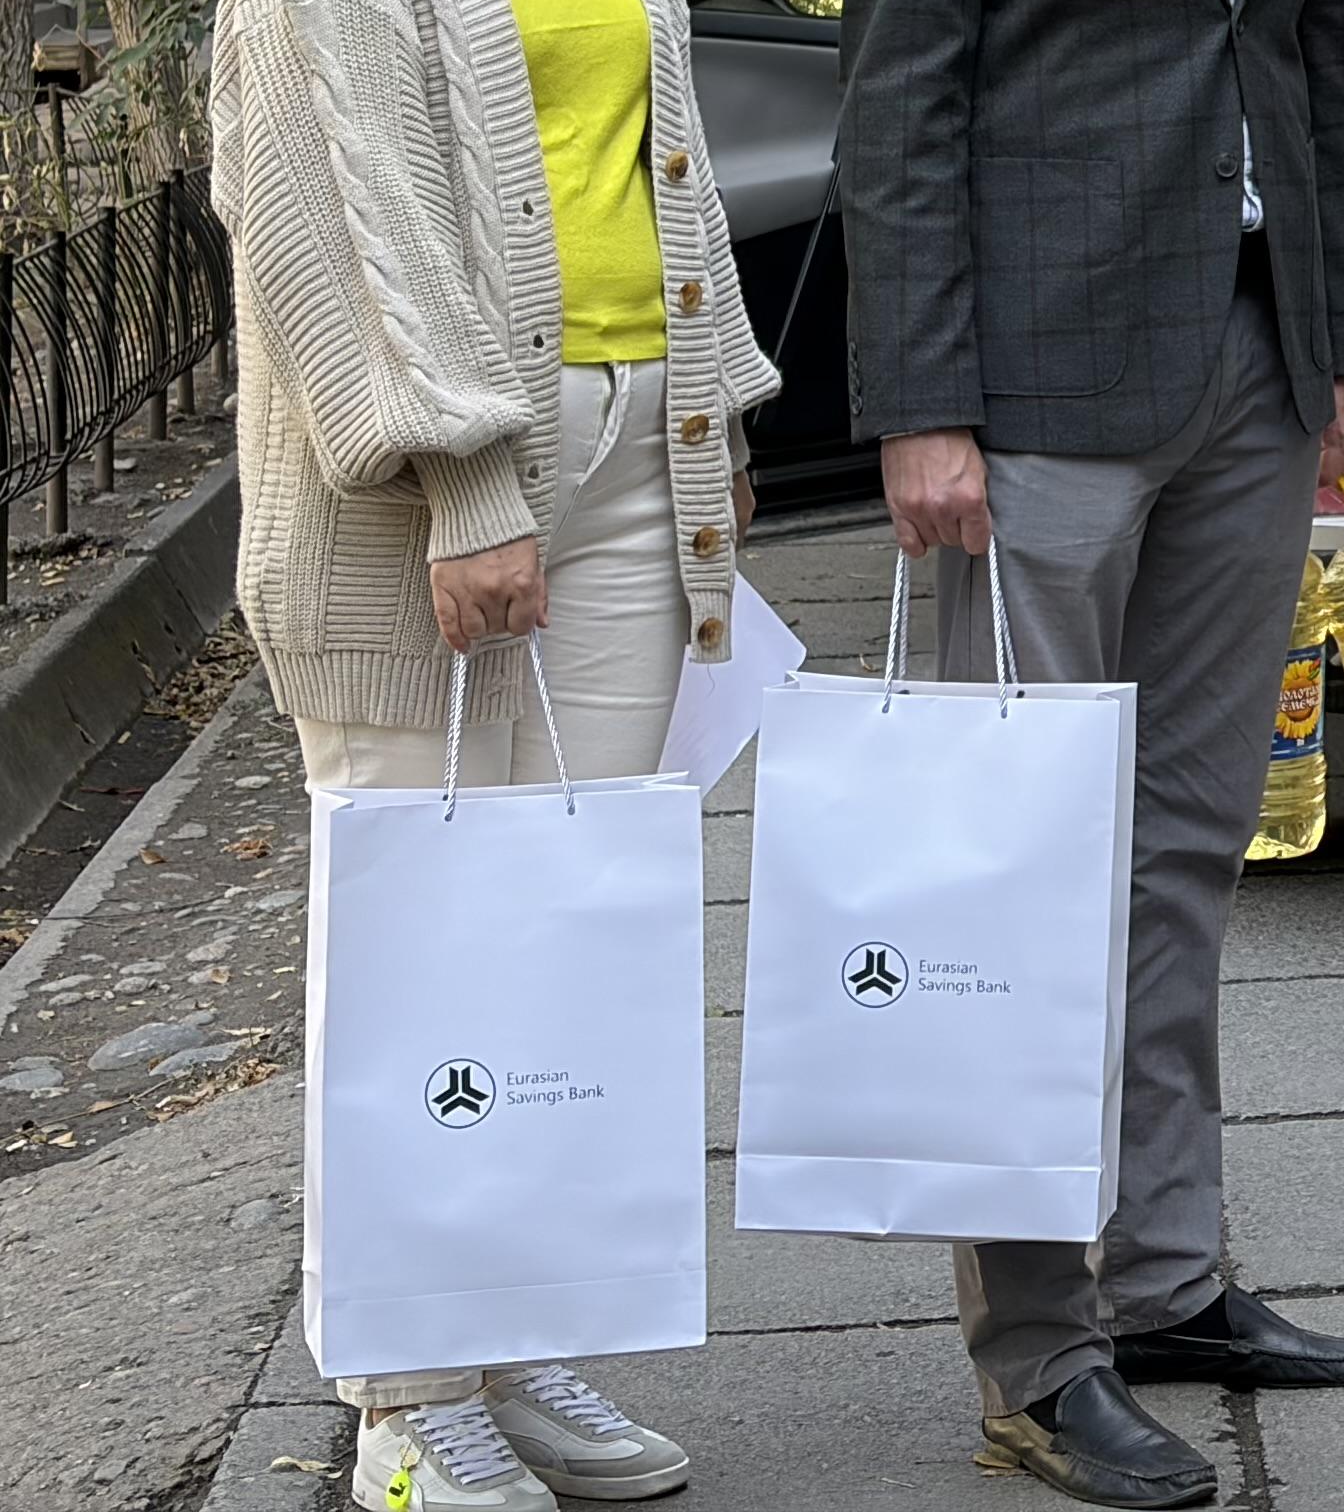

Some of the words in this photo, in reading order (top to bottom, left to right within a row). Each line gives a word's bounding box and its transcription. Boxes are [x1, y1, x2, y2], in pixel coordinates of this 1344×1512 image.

[919, 959, 978, 975] Eurasian
[918, 977, 972, 996] Savings
[976, 979, 1011, 994] Bank
[506, 1069, 569, 1086] Eurasian
[506, 1090, 564, 1106] Savings
[569, 1084, 605, 1100] Bank
